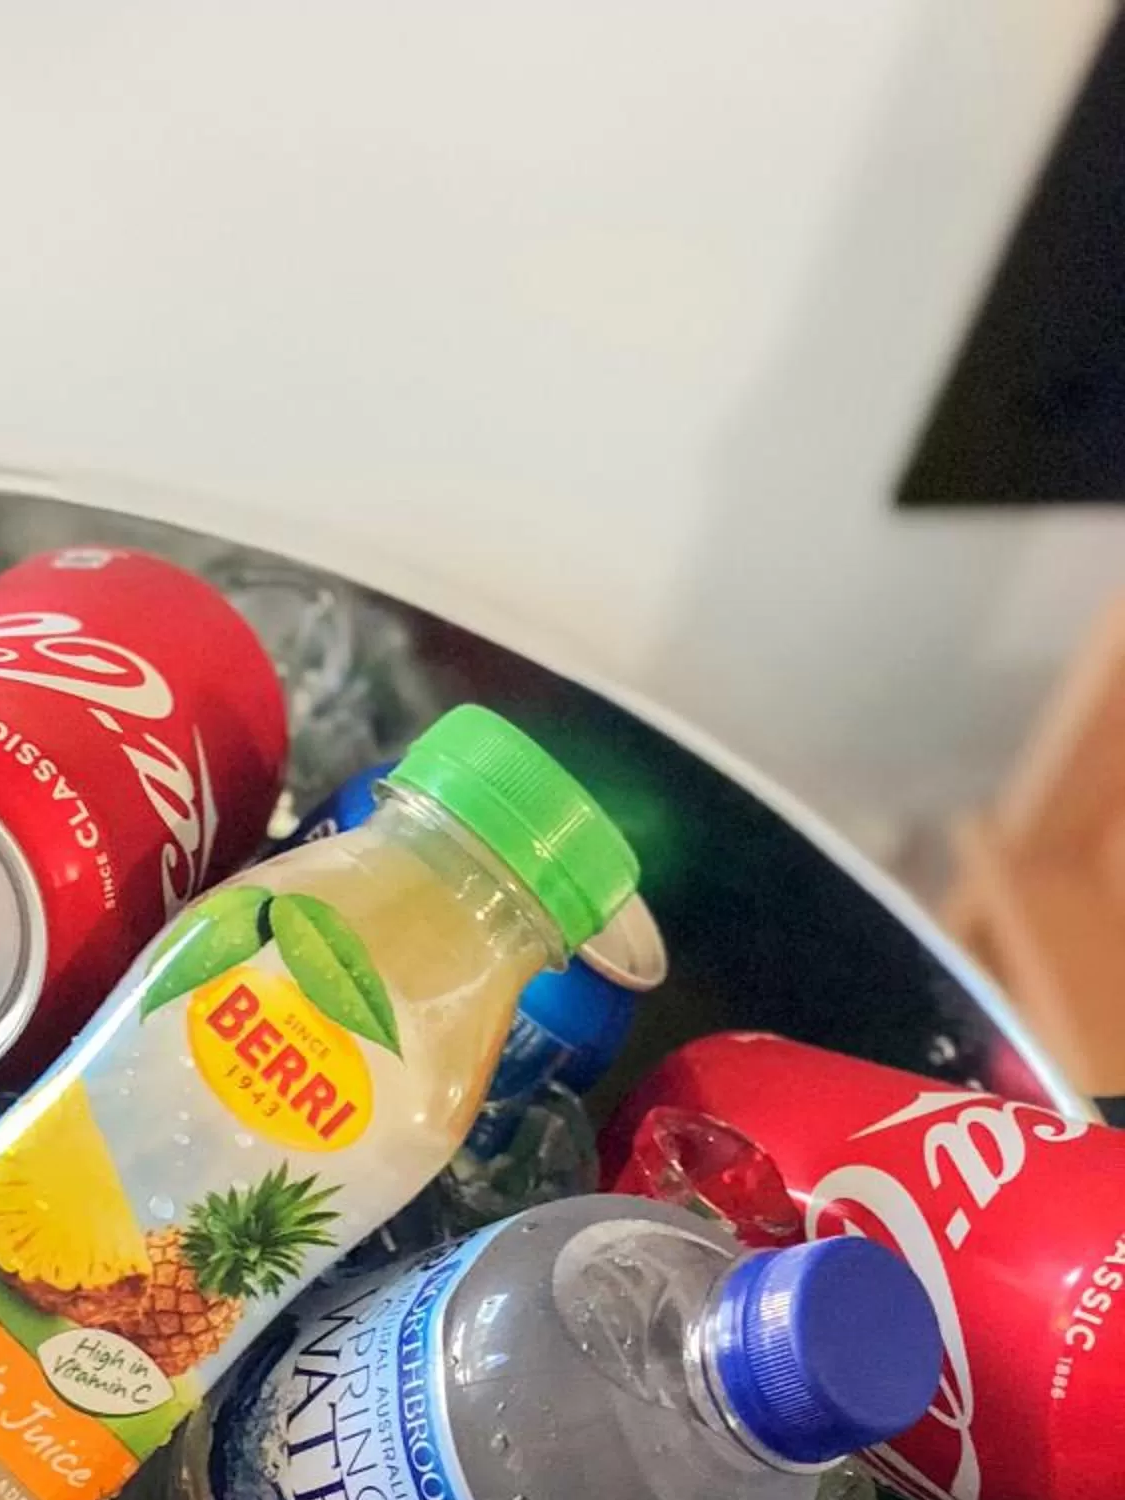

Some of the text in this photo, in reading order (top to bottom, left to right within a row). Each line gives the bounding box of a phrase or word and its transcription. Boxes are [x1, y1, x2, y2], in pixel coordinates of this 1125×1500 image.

[94, 852, 116, 909] SINCE
[206, 984, 358, 1141] BERRI
[284, 1013, 331, 1061] SINCE
[226, 1064, 280, 1118] 1943
[52, 1355, 153, 1405] Vitamin C
[73, 1336, 149, 1379] High in
